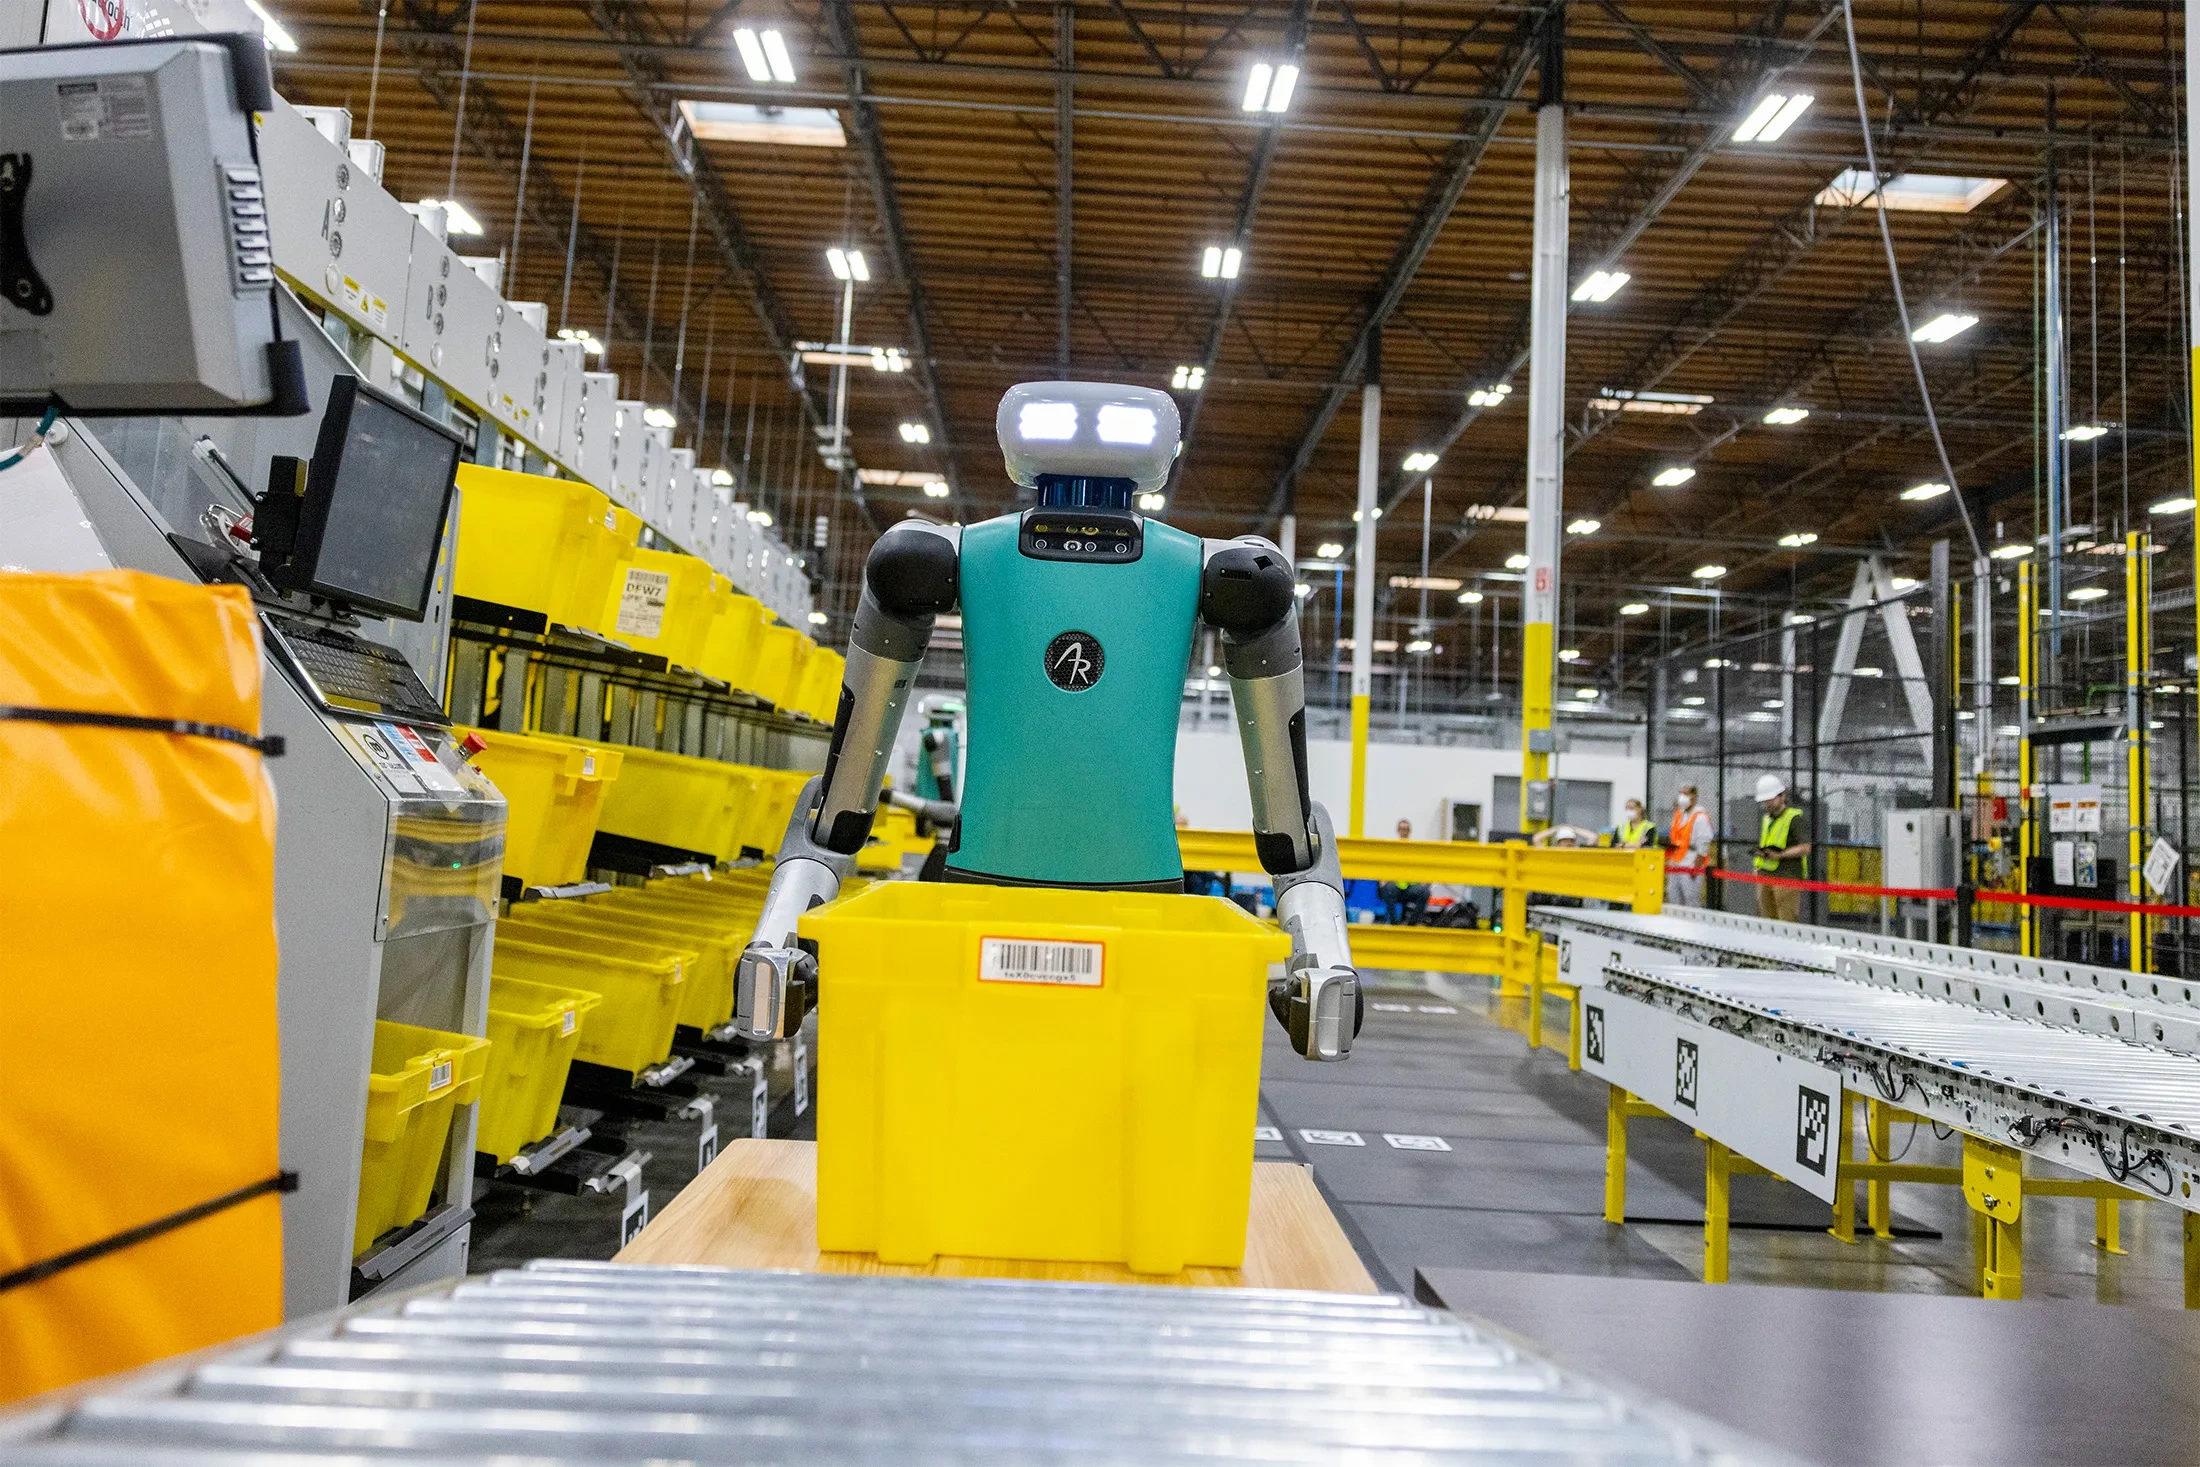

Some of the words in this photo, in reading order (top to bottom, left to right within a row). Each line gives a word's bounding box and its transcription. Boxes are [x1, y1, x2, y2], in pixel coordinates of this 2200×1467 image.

[321, 199, 330, 241] A
[426, 285, 433, 320] B
[1054, 642, 1091, 684] AR
